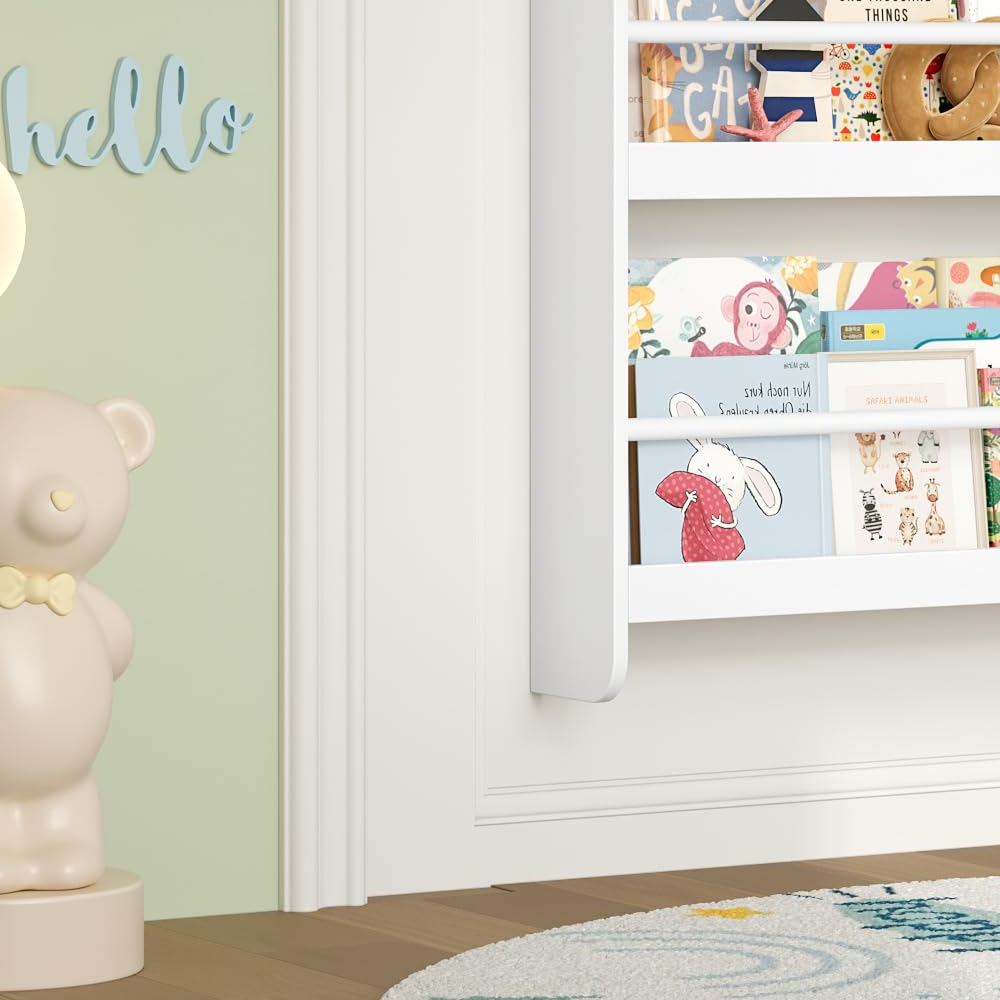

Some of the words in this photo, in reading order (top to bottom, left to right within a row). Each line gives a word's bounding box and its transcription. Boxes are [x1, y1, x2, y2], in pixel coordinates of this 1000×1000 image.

[865, 8, 909, 22] THINGS
[1, 54, 256, 175] hello
[865, 395, 893, 405] SAFARI
[895, 394, 929, 404] ANIMALS
